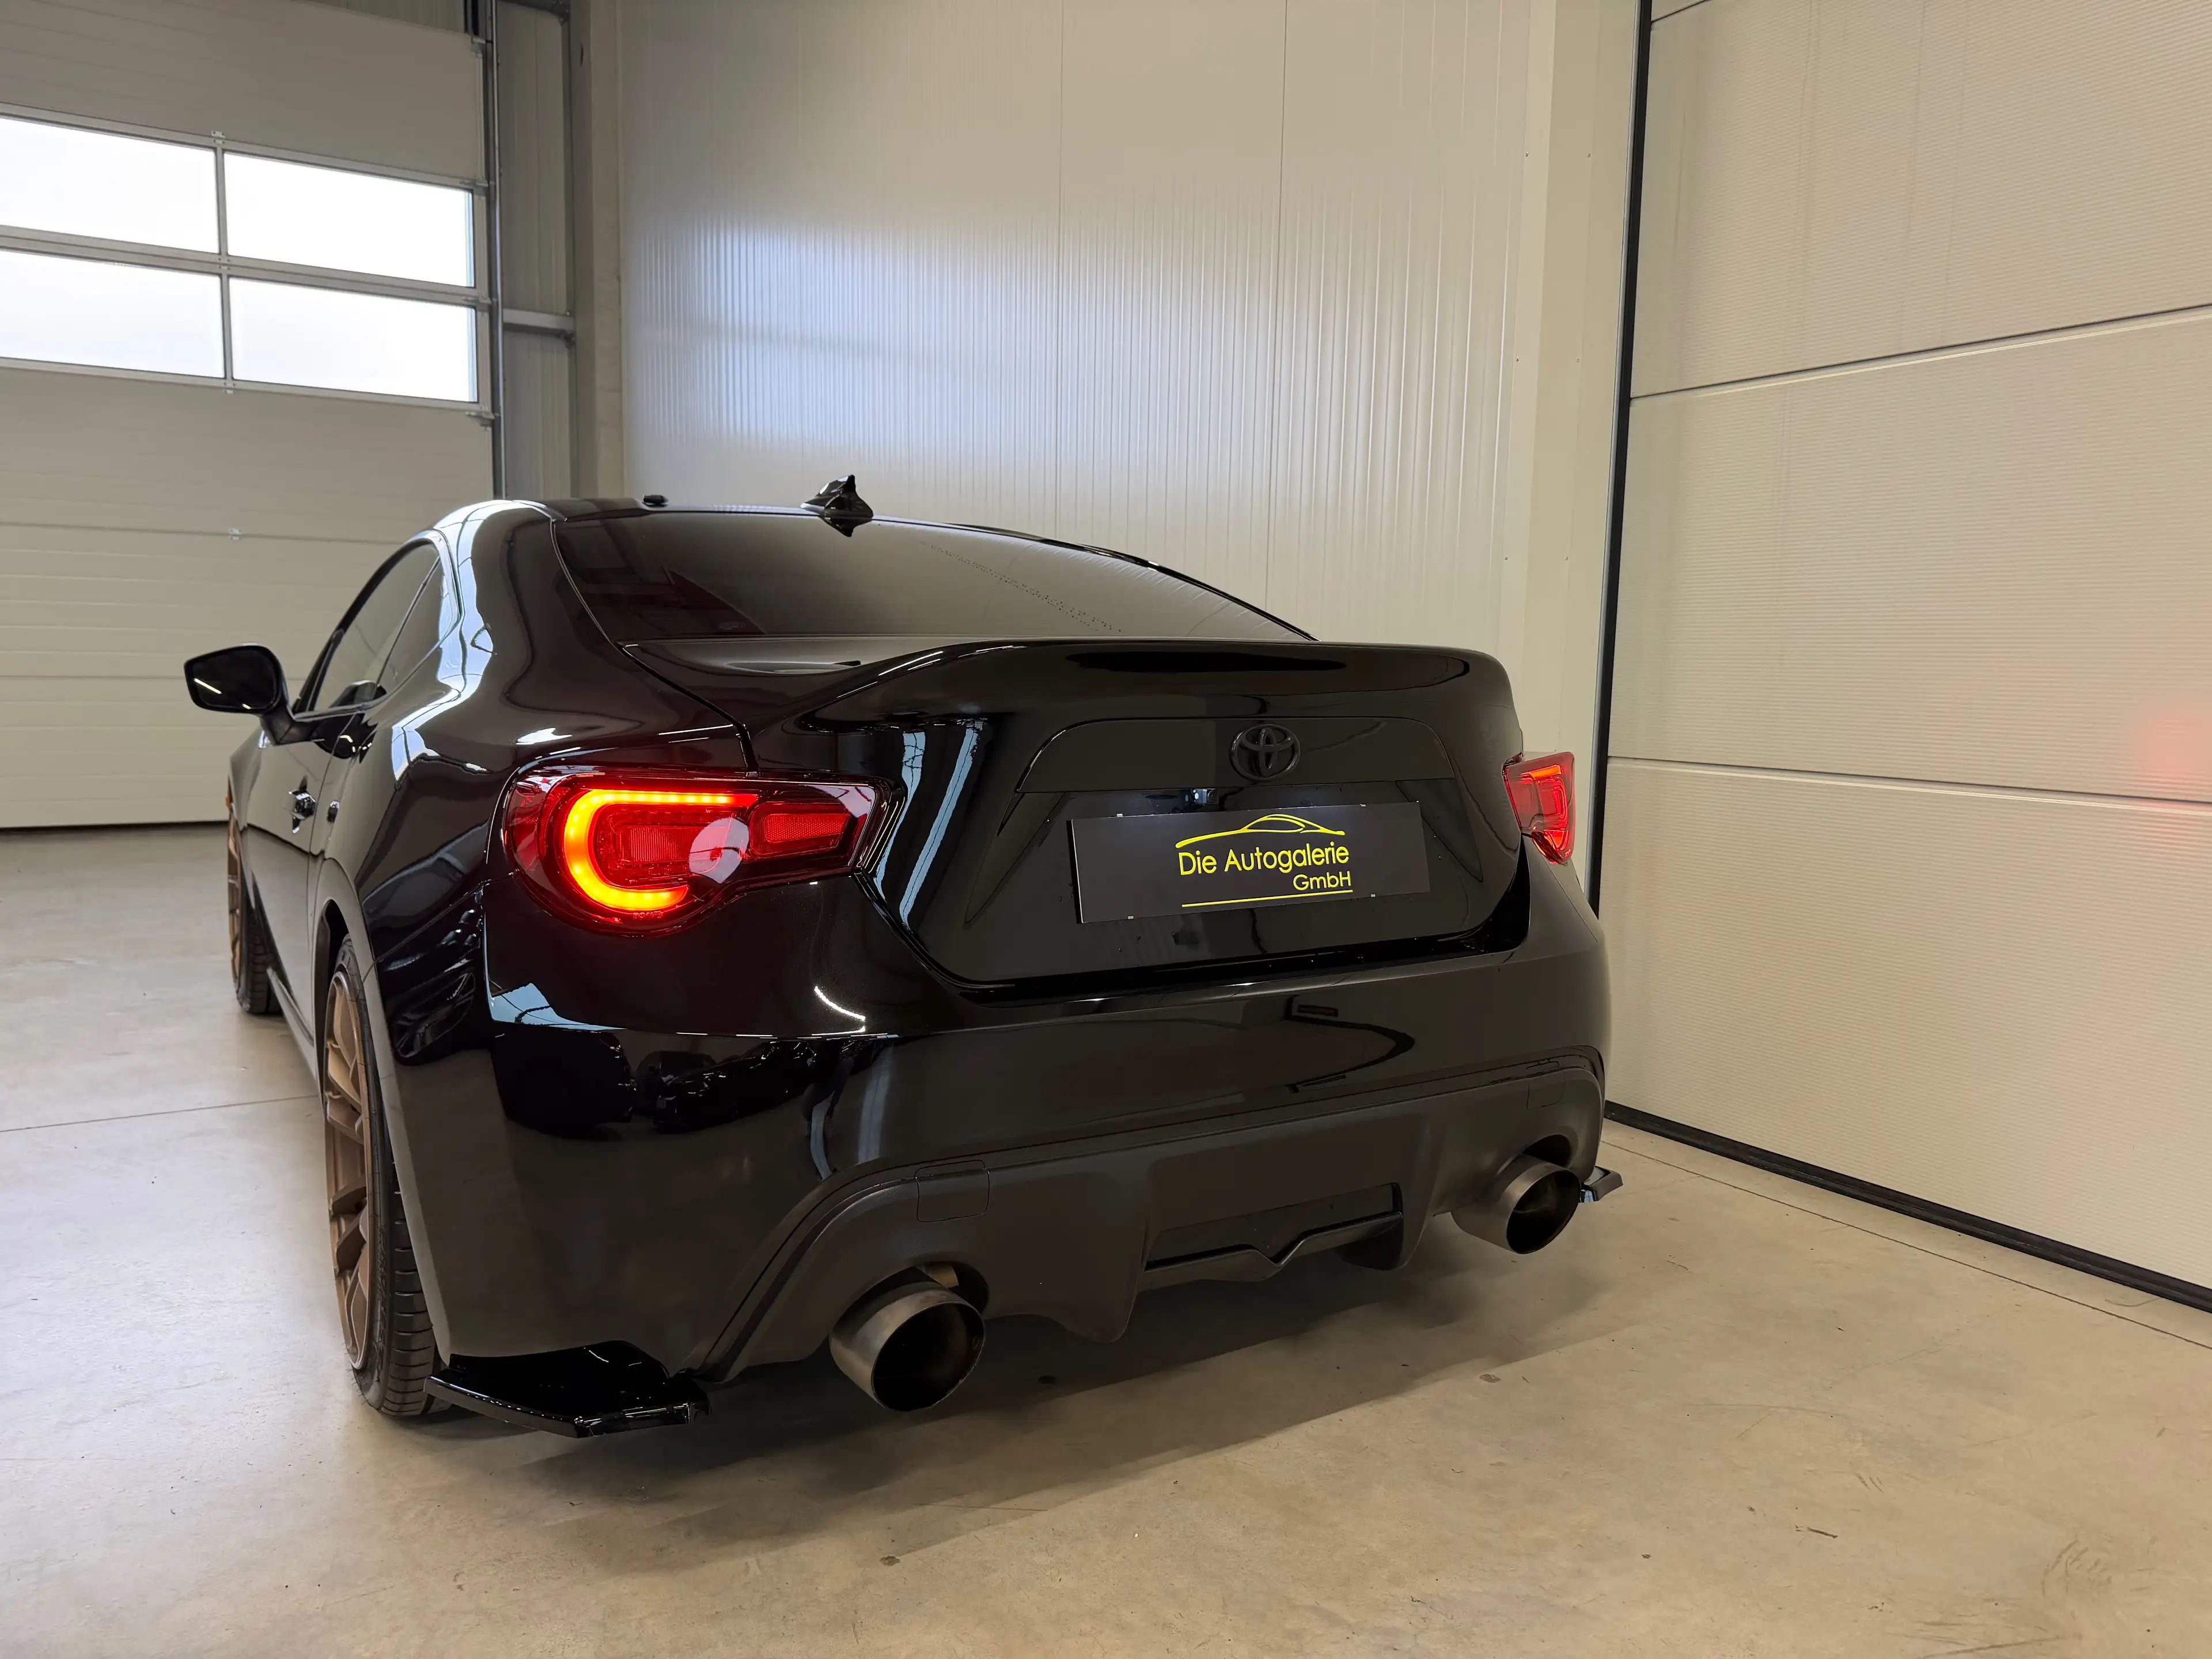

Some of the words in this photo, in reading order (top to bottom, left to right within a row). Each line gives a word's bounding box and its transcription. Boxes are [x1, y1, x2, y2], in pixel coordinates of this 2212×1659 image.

[1178, 851, 1217, 876] Die
[1225, 842, 1350, 874] Autogalerie
[1293, 872, 1352, 891] GmbH
